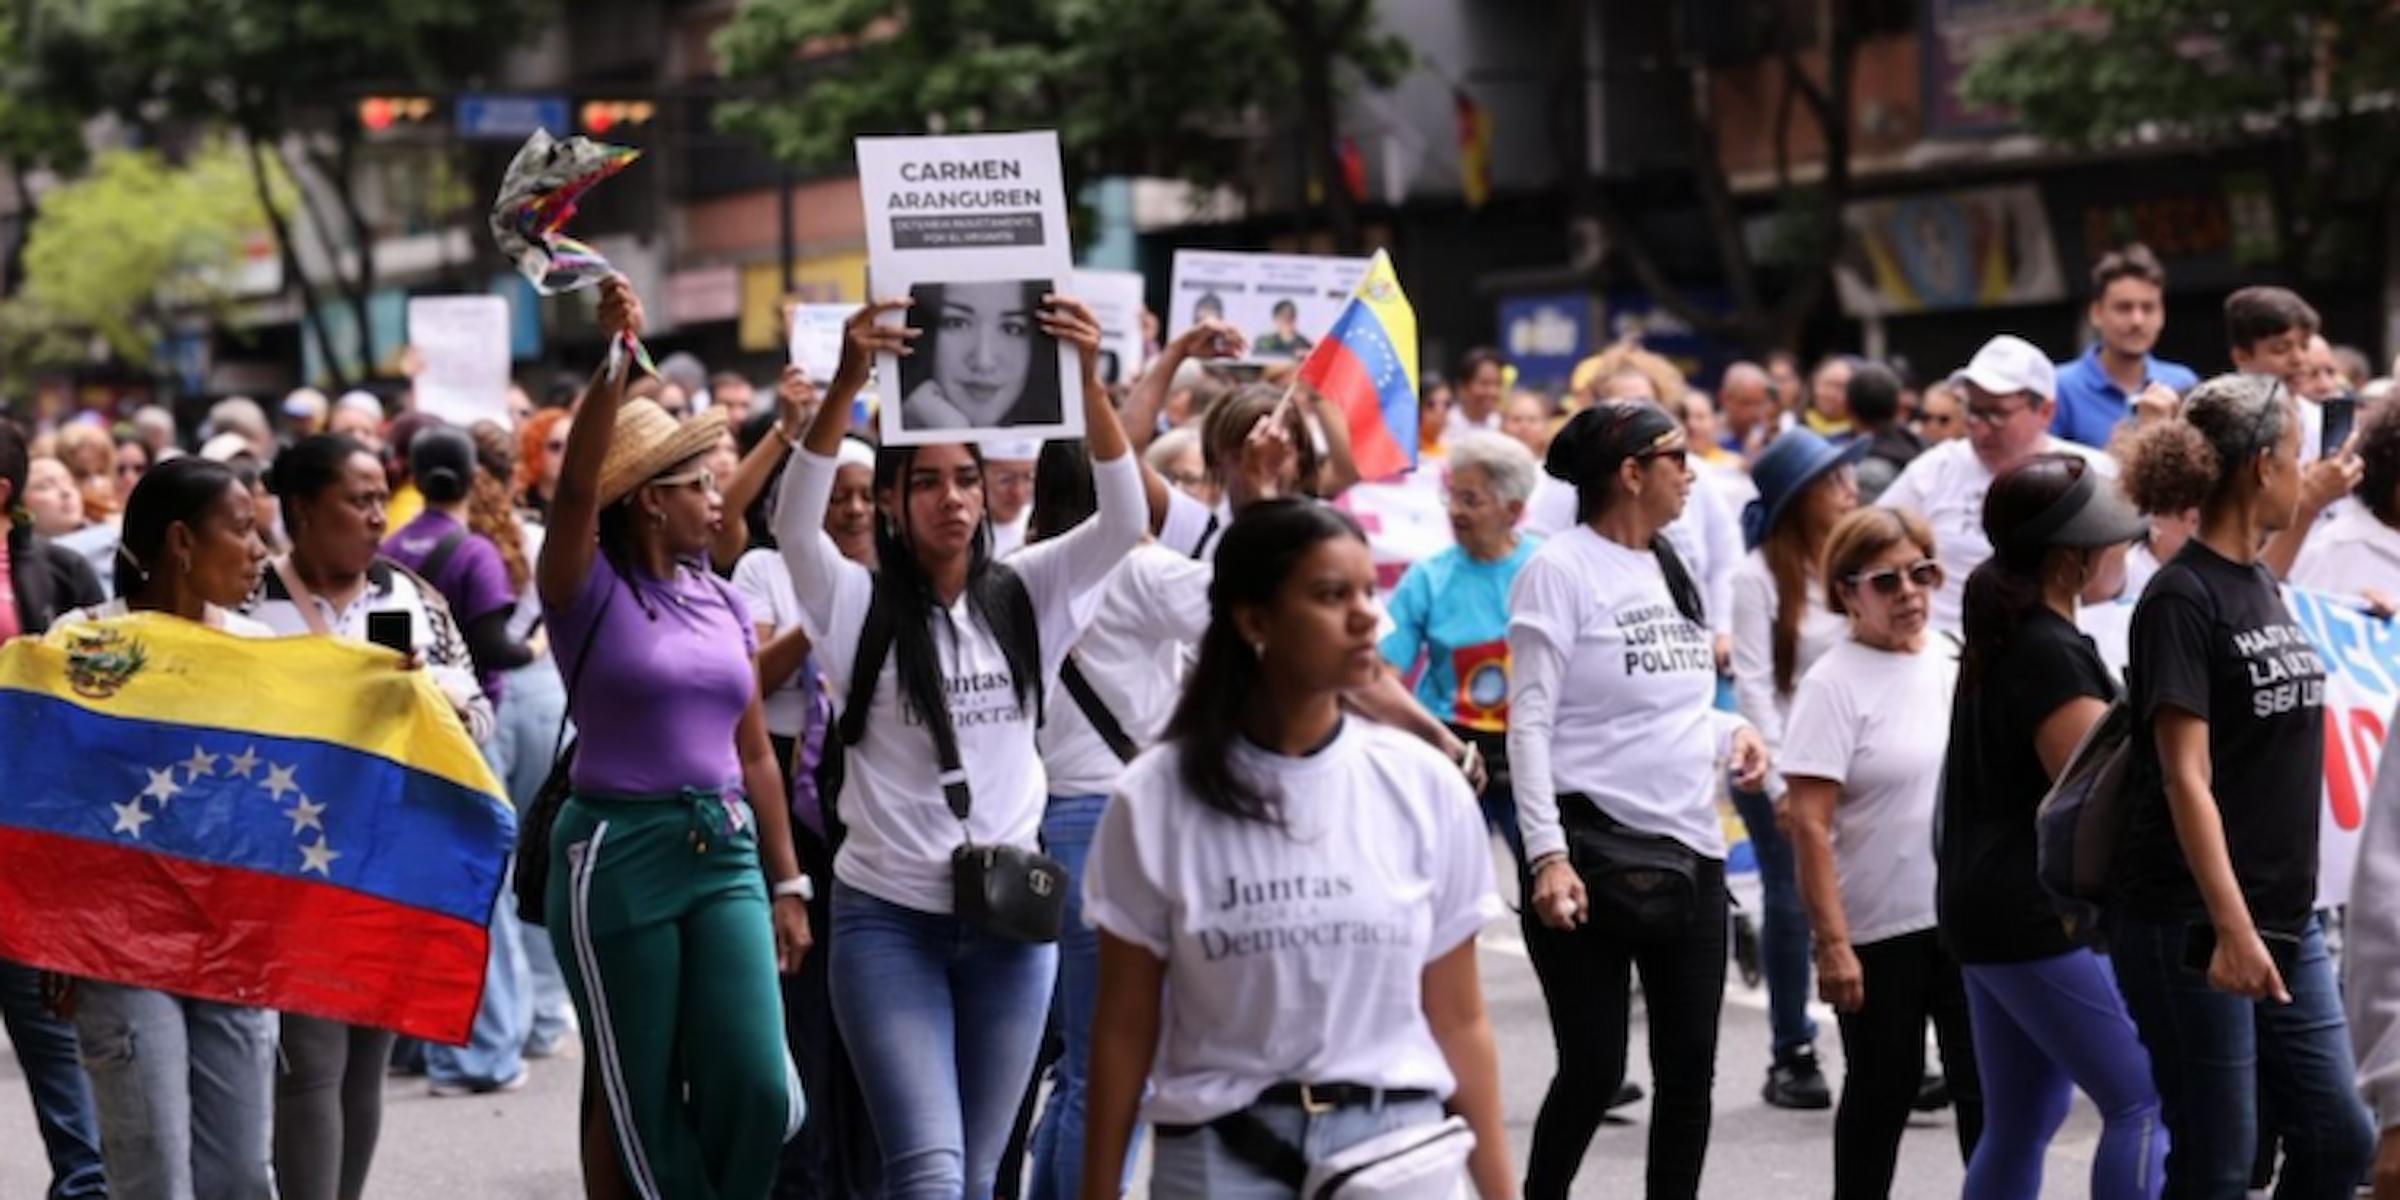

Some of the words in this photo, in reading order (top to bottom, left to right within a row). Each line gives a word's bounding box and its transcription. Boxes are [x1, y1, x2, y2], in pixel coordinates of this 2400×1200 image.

[900, 160, 1021, 182] CARMEN
[888, 189, 1041, 209] ARANGUREN
[1623, 624, 1657, 646] LOS
[2247, 656, 2289, 688] LA
[942, 673, 1009, 694] untas
[1219, 875, 1354, 911] Juntas
[1200, 919, 1413, 961] Democracia
